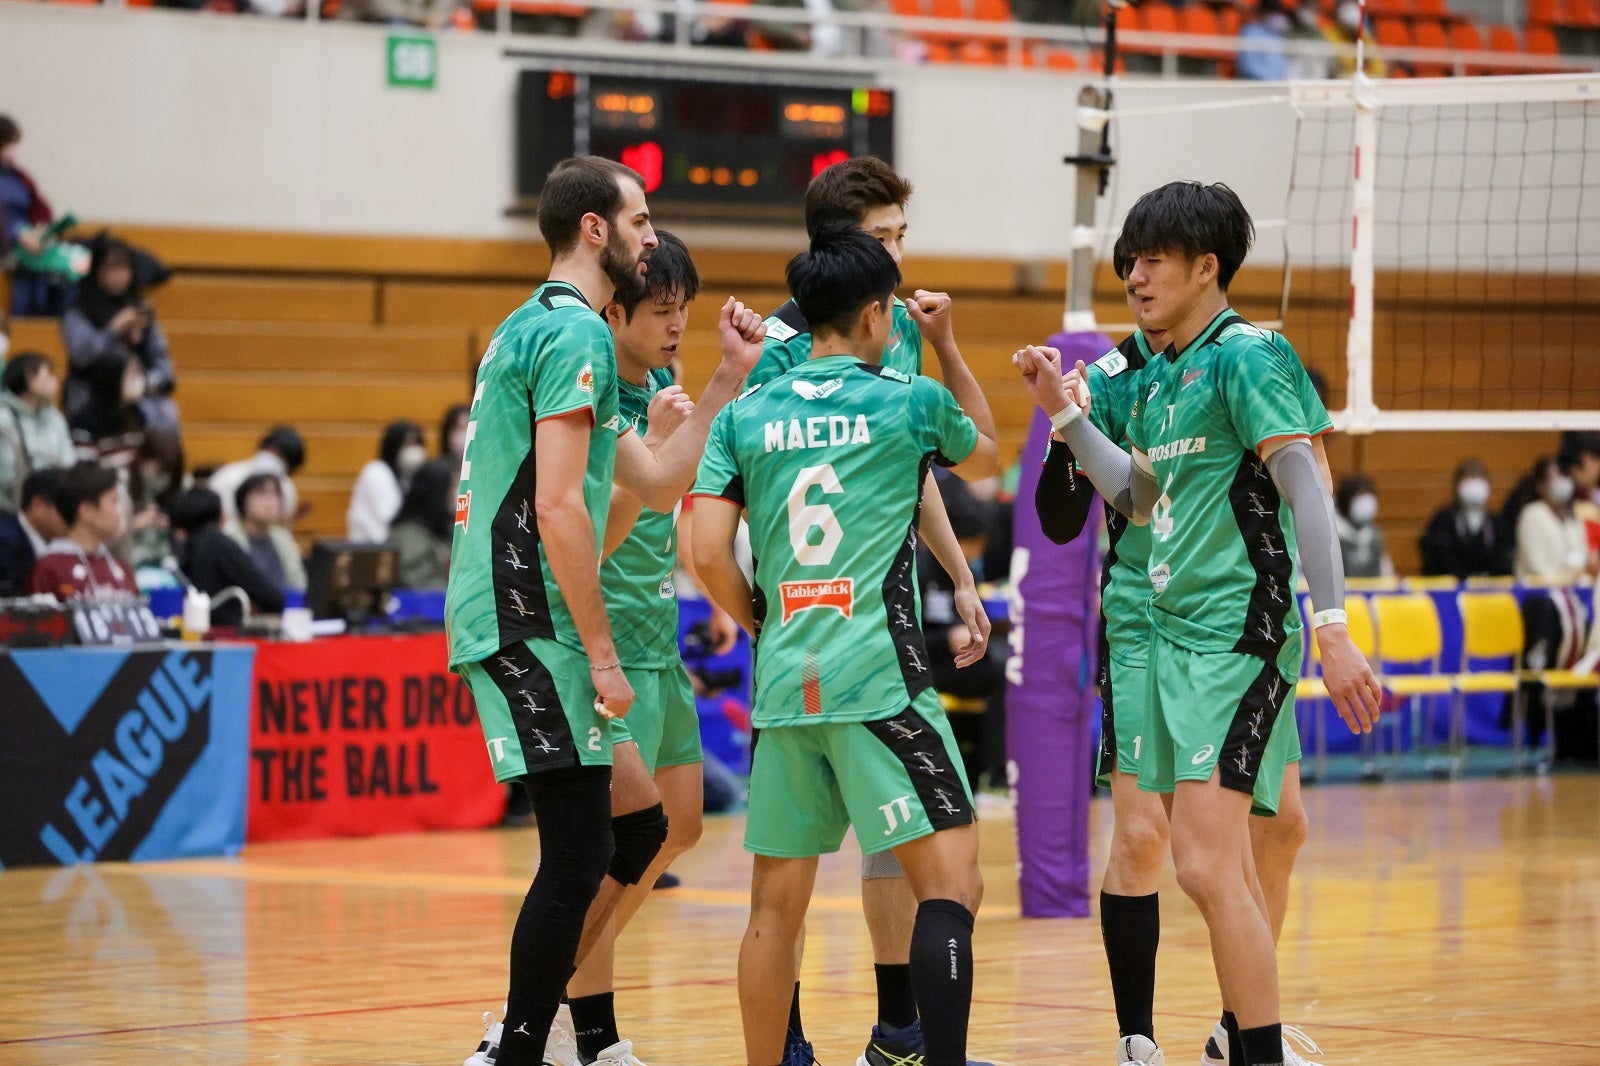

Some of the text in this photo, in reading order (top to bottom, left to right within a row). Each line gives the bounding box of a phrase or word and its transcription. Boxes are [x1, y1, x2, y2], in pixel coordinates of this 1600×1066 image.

[764, 414, 870, 452] MAEDA
[788, 463, 844, 566] 6
[258, 675, 386, 734] NEVER
[403, 674, 476, 729] DRO
[40, 650, 213, 866] LEAGUE
[588, 726, 601, 751] 2
[252, 742, 439, 801] THE BALL
[878, 795, 911, 836] JT
